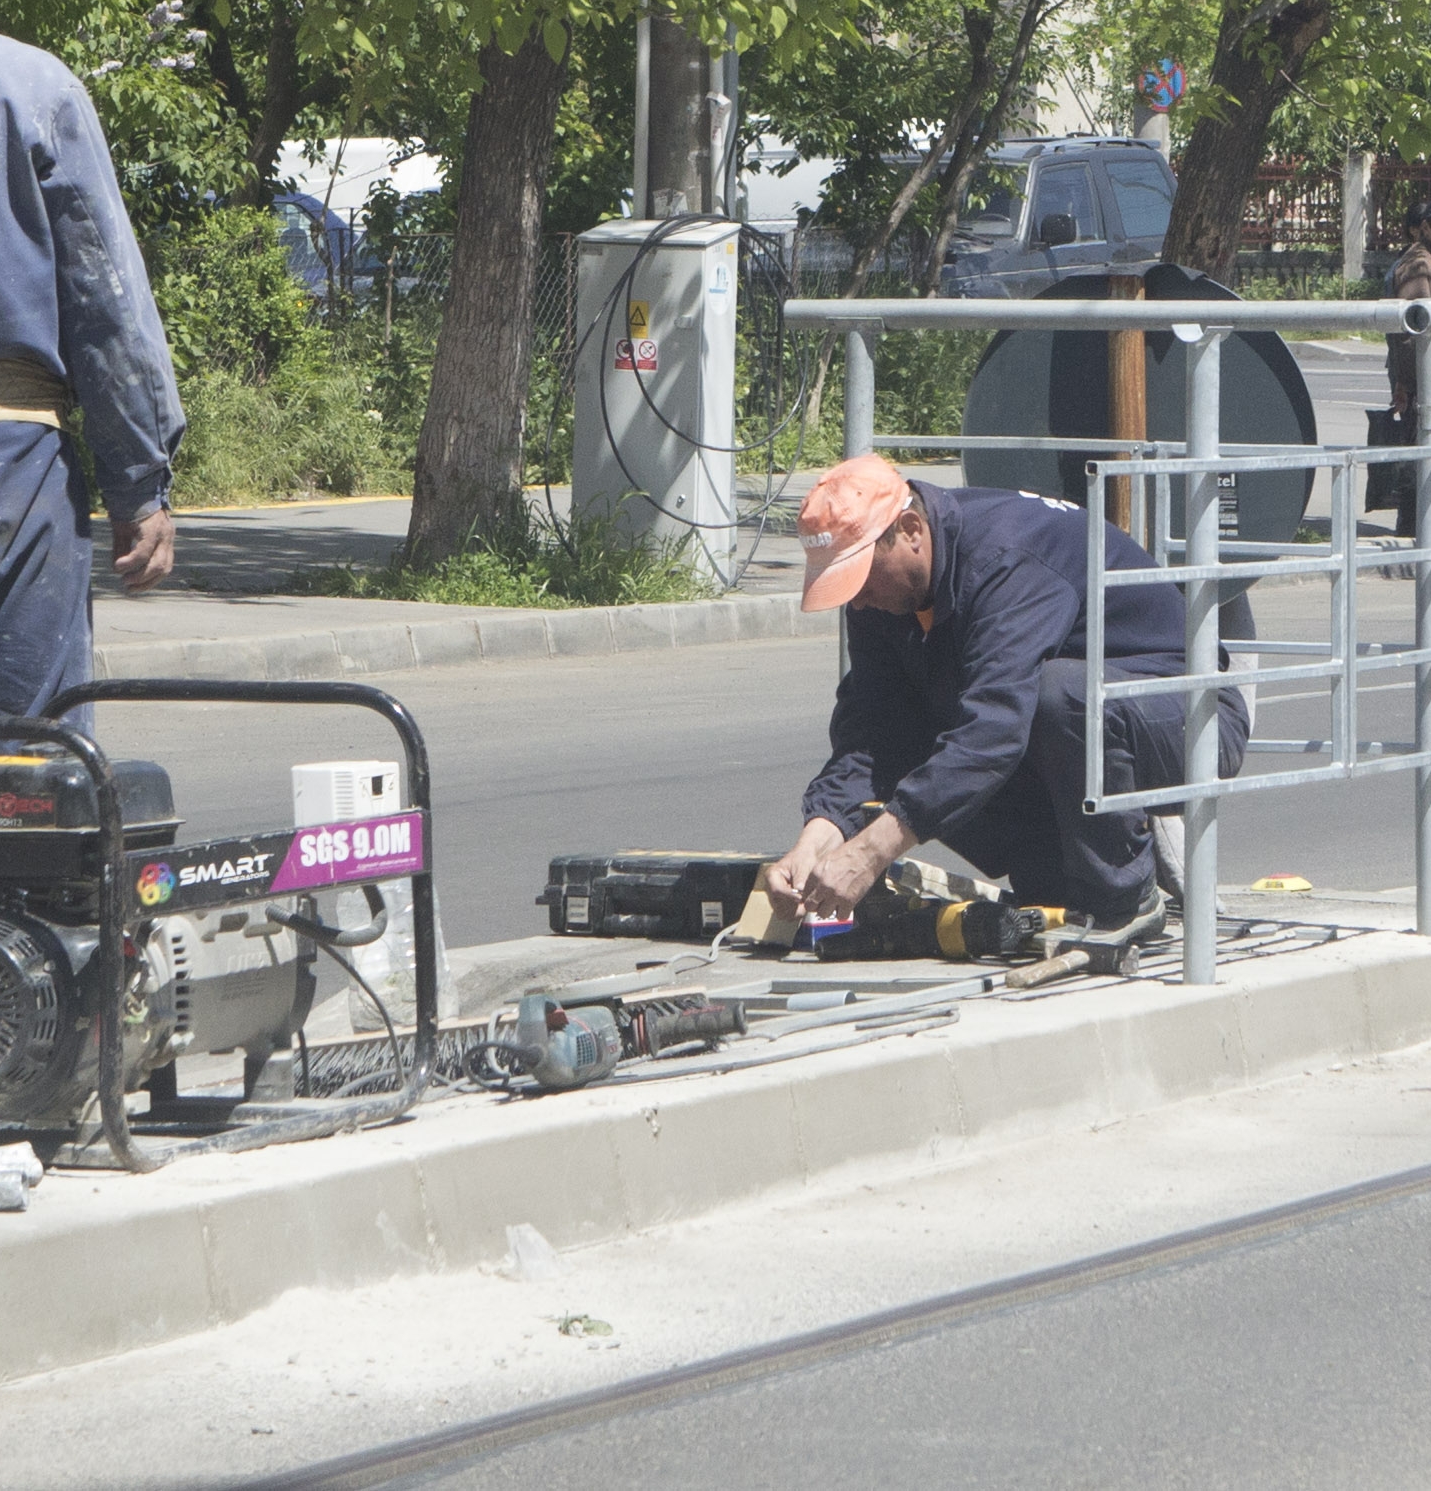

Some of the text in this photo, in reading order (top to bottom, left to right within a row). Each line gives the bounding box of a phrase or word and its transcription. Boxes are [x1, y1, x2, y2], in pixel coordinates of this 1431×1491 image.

[299, 821, 412, 867] SGS 9.0M
[179, 853, 275, 887] SMART
